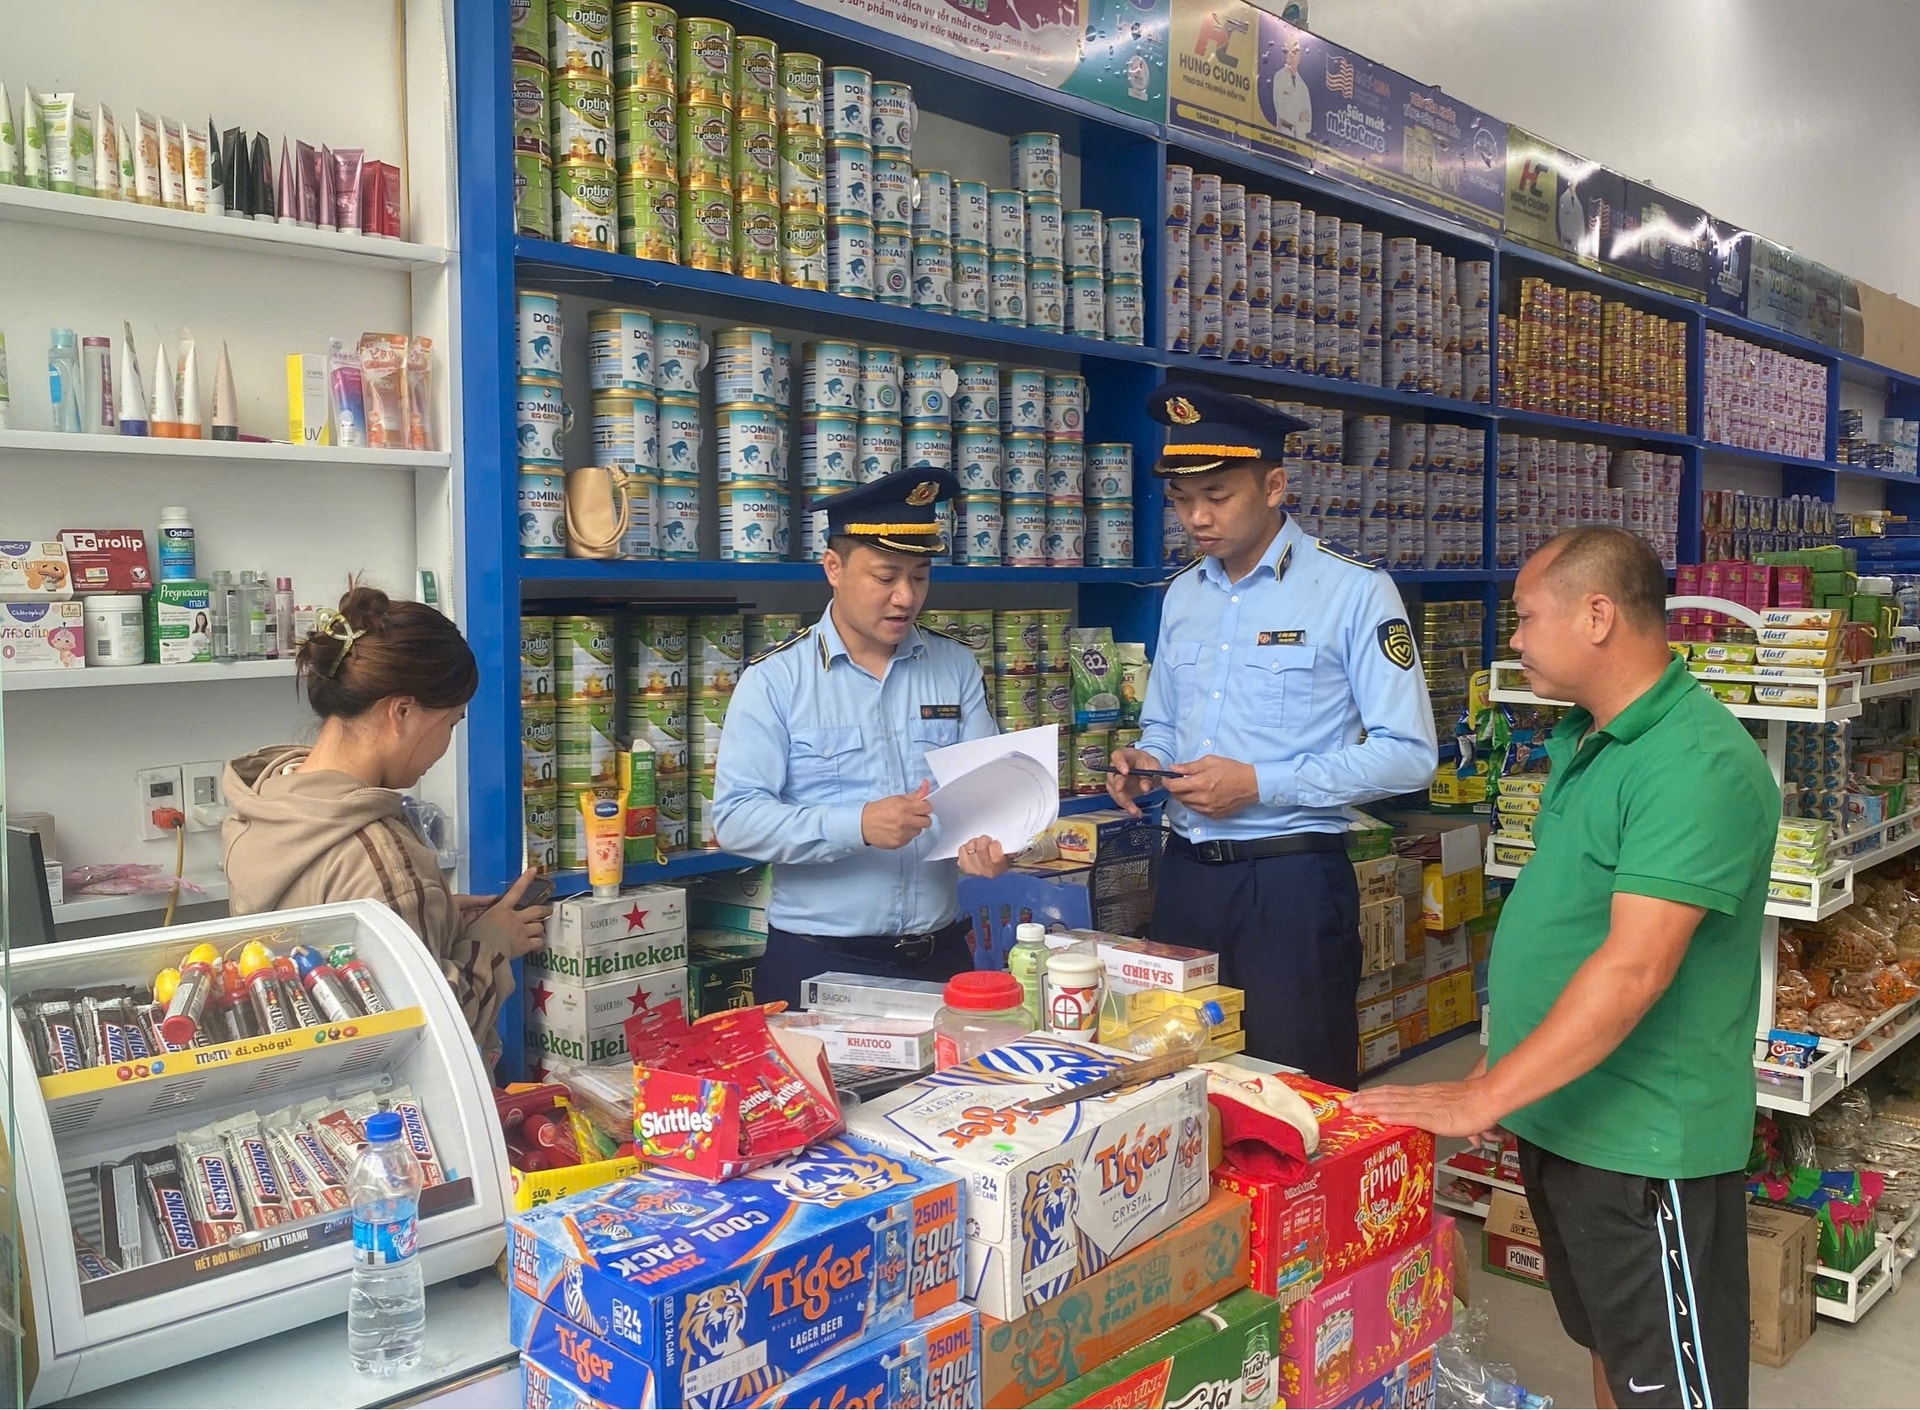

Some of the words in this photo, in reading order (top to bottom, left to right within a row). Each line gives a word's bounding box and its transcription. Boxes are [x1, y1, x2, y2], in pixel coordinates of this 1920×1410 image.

[896, 12, 918, 29] vàng
[972, 23, 988, 36] cho
[1179, 53, 1211, 77] HUNG
[1213, 65, 1251, 91] CUONG
[304, 427, 322, 441] UV
[73, 535, 143, 552] Ferrolip
[160, 584, 208, 601] Pregnacare
[189, 600, 206, 608] max
[585, 943, 686, 979] Heineken
[1122, 963, 1149, 979] BIRD
[1153, 968, 1174, 985] SEA
[821, 992, 851, 1003] SAIGON
[590, 1033, 630, 1063] Hei
[847, 1037, 892, 1049] KHATOCO
[402, 1106, 430, 1155] SNICKERS
[640, 1106, 713, 1138] Skittles
[1094, 1122, 1172, 1199] Tiger
[1178, 1136, 1202, 1169] Tiger
[249, 1141, 279, 1196] SNICKERS
[982, 1175, 998, 1191] 24
[205, 1159, 235, 1213] SNICKERS
[982, 1190, 998, 1202] CANS
[163, 1190, 196, 1250] SNICKERS
[914, 1198, 958, 1227] 250ML
[1111, 1191, 1153, 1223] CRYSTAL
[280, 1230, 309, 1245] THANH
[690, 1208, 771, 1245] COOL
[912, 1217, 963, 1263] COOL
[514, 1229, 539, 1258] COOL
[608, 1237, 696, 1278] PACK
[513, 1248, 540, 1279] PACK
[629, 1255, 707, 1286] 250ML
[877, 1258, 906, 1283] Tiger
[909, 1249, 961, 1300] PACK
[1509, 1250, 1540, 1271] PONNIE
[763, 1243, 873, 1321] Tiger
[623, 1304, 642, 1333] 24
[789, 1326, 819, 1350] LAGER
[819, 1315, 844, 1341] BEER
[623, 1328, 642, 1346] CANS
[665, 1328, 674, 1341] 24
[928, 1326, 972, 1361] 250ML
[555, 1323, 613, 1384] Tiger
[665, 1341, 675, 1367] CANS
[526, 1366, 551, 1394] COOL
[926, 1351, 976, 1398] COOL
